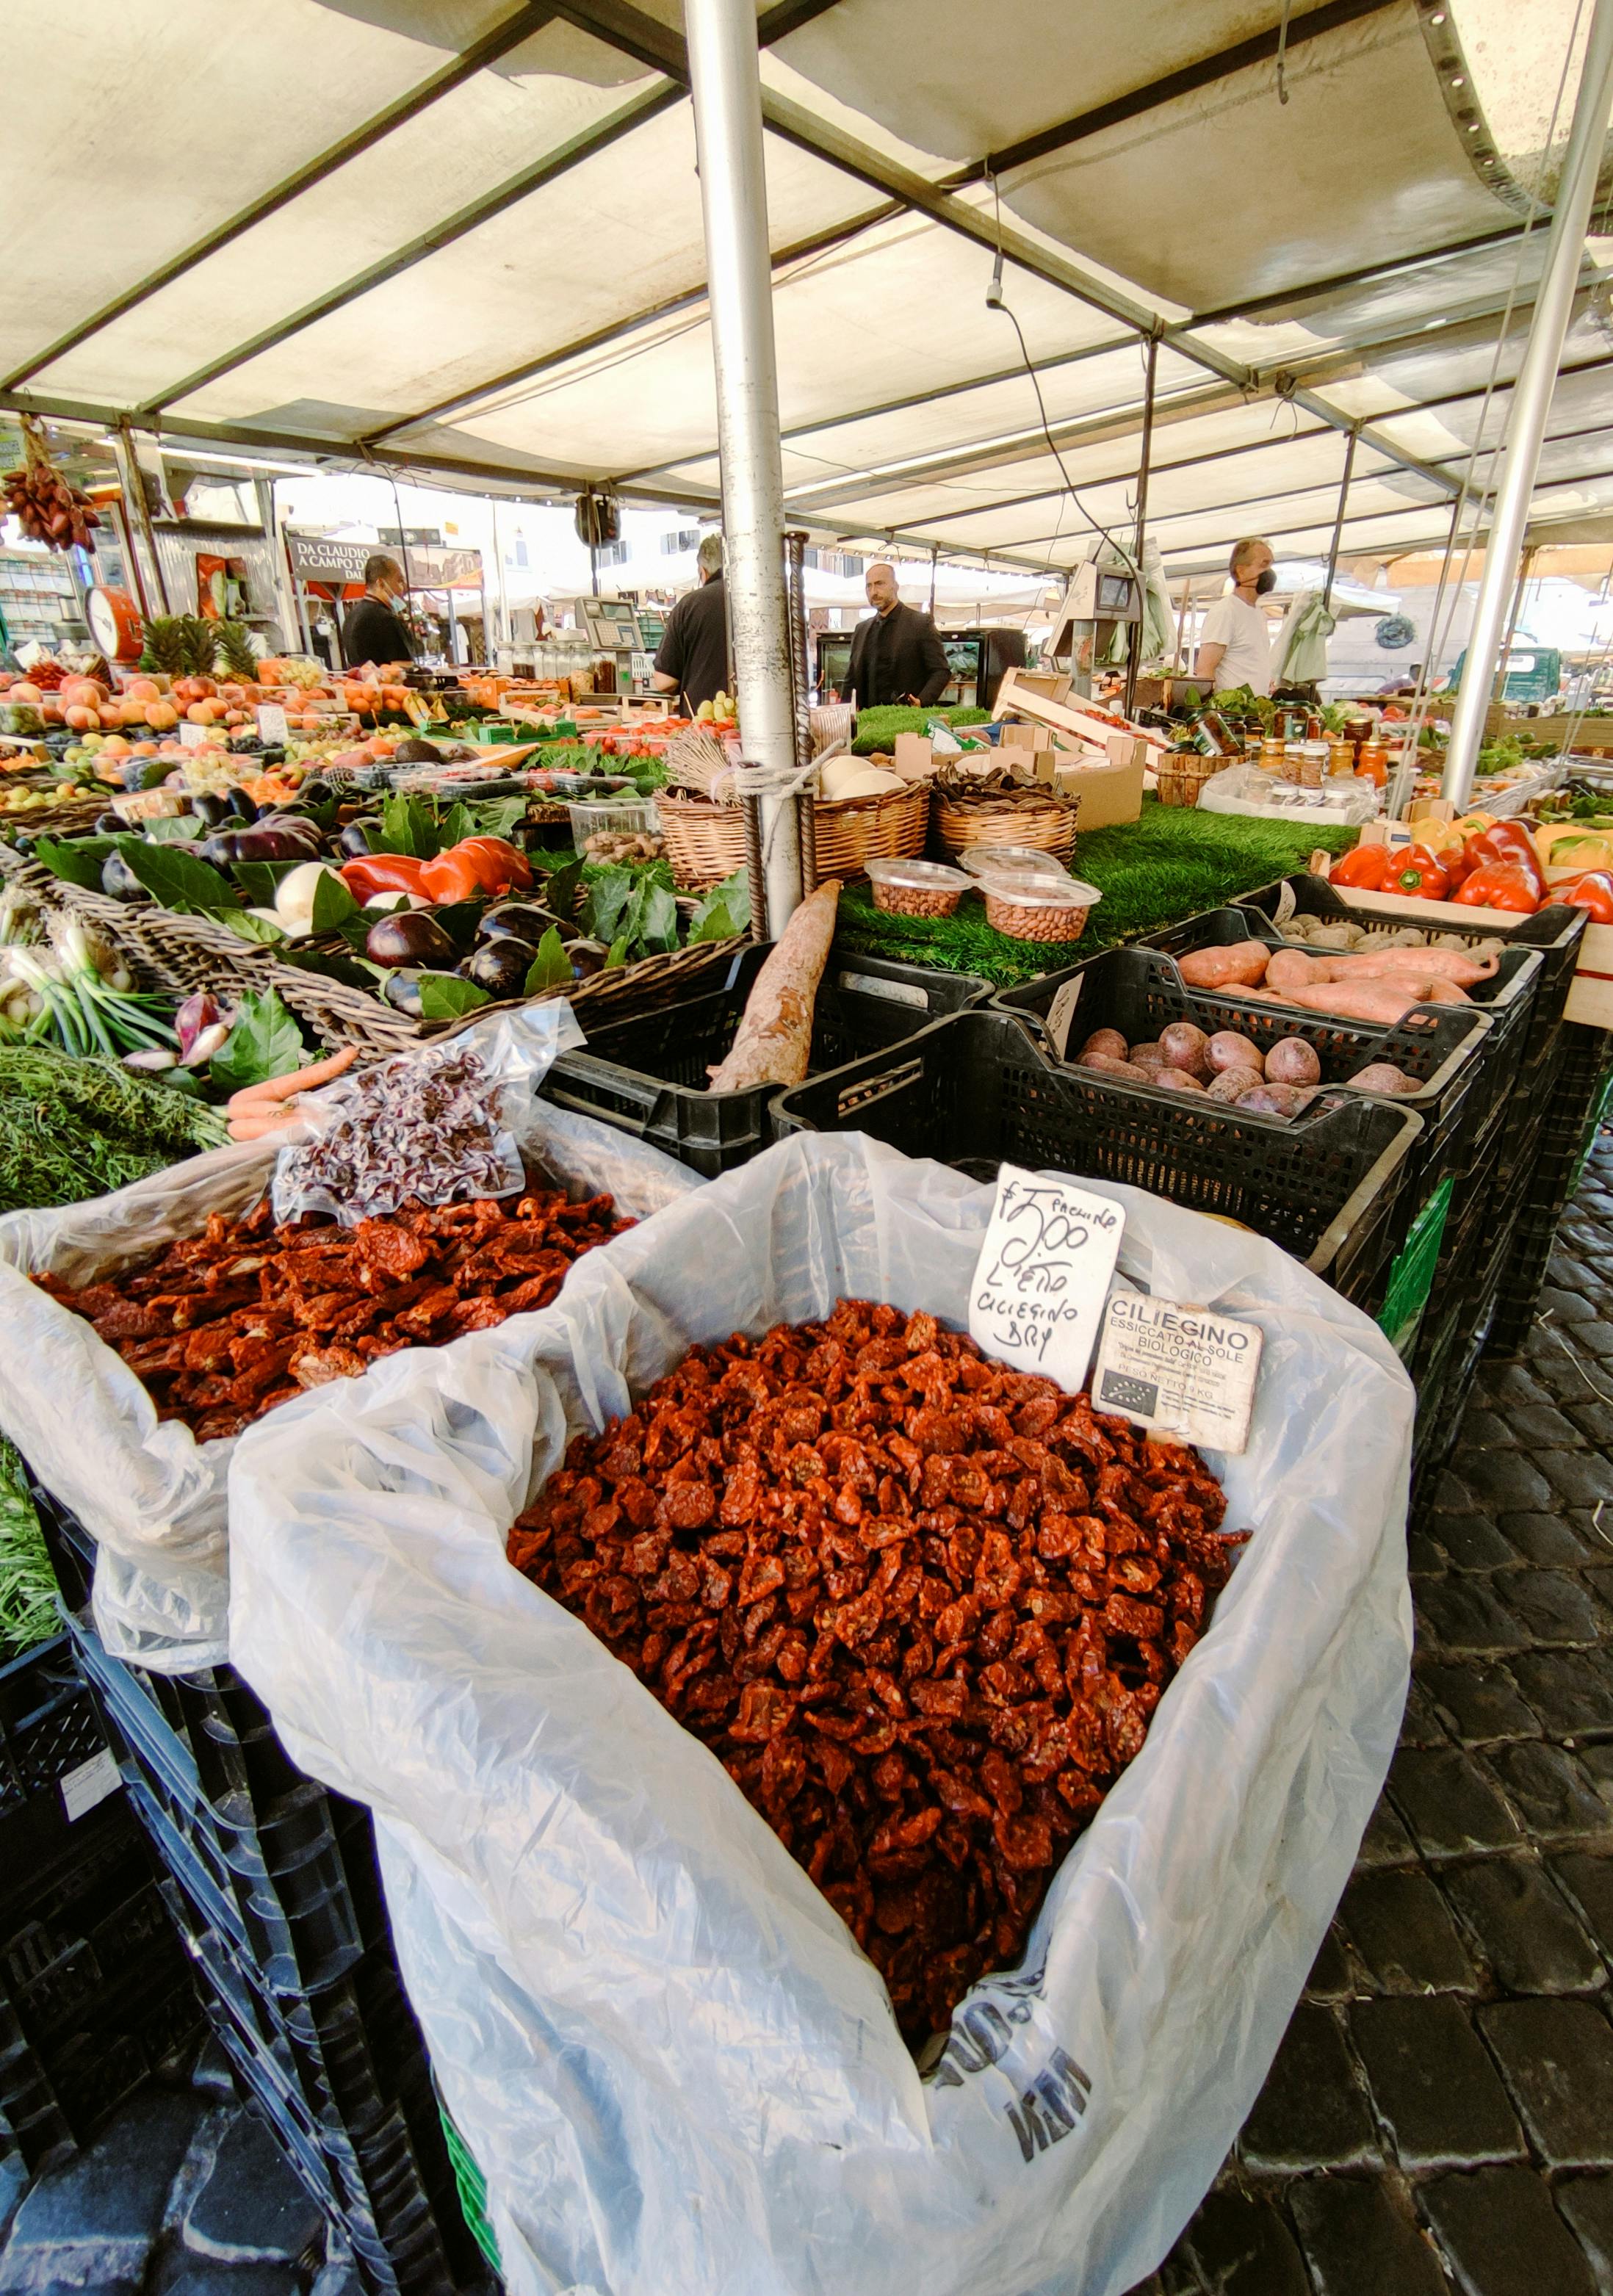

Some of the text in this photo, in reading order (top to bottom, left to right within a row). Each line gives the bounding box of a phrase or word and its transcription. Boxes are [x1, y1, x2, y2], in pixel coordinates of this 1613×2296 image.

[297, 542, 370, 559] DA CLAUDIO
[299, 556, 308, 566] A
[309, 556, 353, 569] CAMPO
[345, 570, 364, 580] DAL
[993, 1321, 1053, 1362] DRY
[1111, 1300, 1249, 1350] CILIEGINO
[1111, 1316, 1184, 1345] ESSICCATO
[1188, 1340, 1205, 1352] AL
[1208, 1346, 1244, 1364] SOLE
[1139, 1336, 1212, 1367] BIOLOGICO
[1119, 1364, 1147, 1379] PESO
[1150, 1373, 1187, 1391] NETTO
[1197, 1387, 1213, 1399] KG
